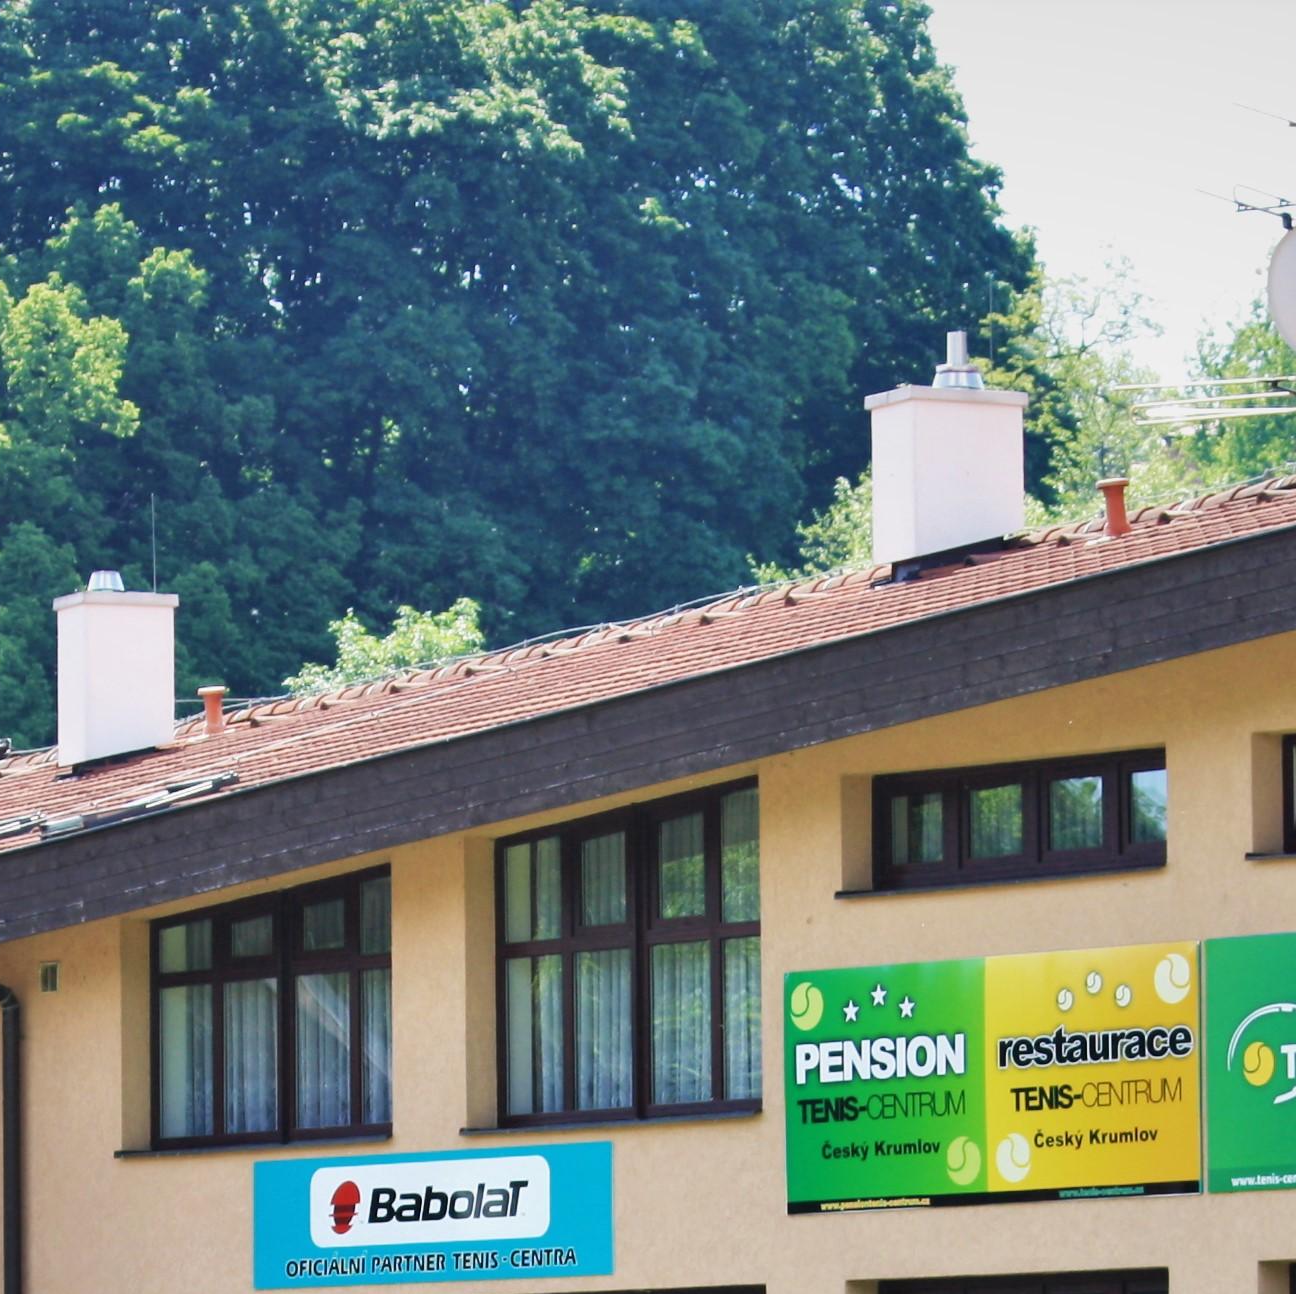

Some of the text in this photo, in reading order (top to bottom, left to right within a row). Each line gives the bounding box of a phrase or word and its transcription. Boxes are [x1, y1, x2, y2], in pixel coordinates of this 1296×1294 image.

[795, 1033, 966, 1085] PENSION
[998, 1025, 1193, 1069] restaurace
[798, 1090, 966, 1125] TENIS-CENTRUM
[1011, 1077, 1183, 1112] TENIS-CENTRUM
[821, 1138, 941, 1162] Český Krumlov
[1034, 1127, 1158, 1150] Český Krumlov
[286, 1251, 366, 1277] OFICIÁLNÍ
[371, 1253, 446, 1274] PARTNER
